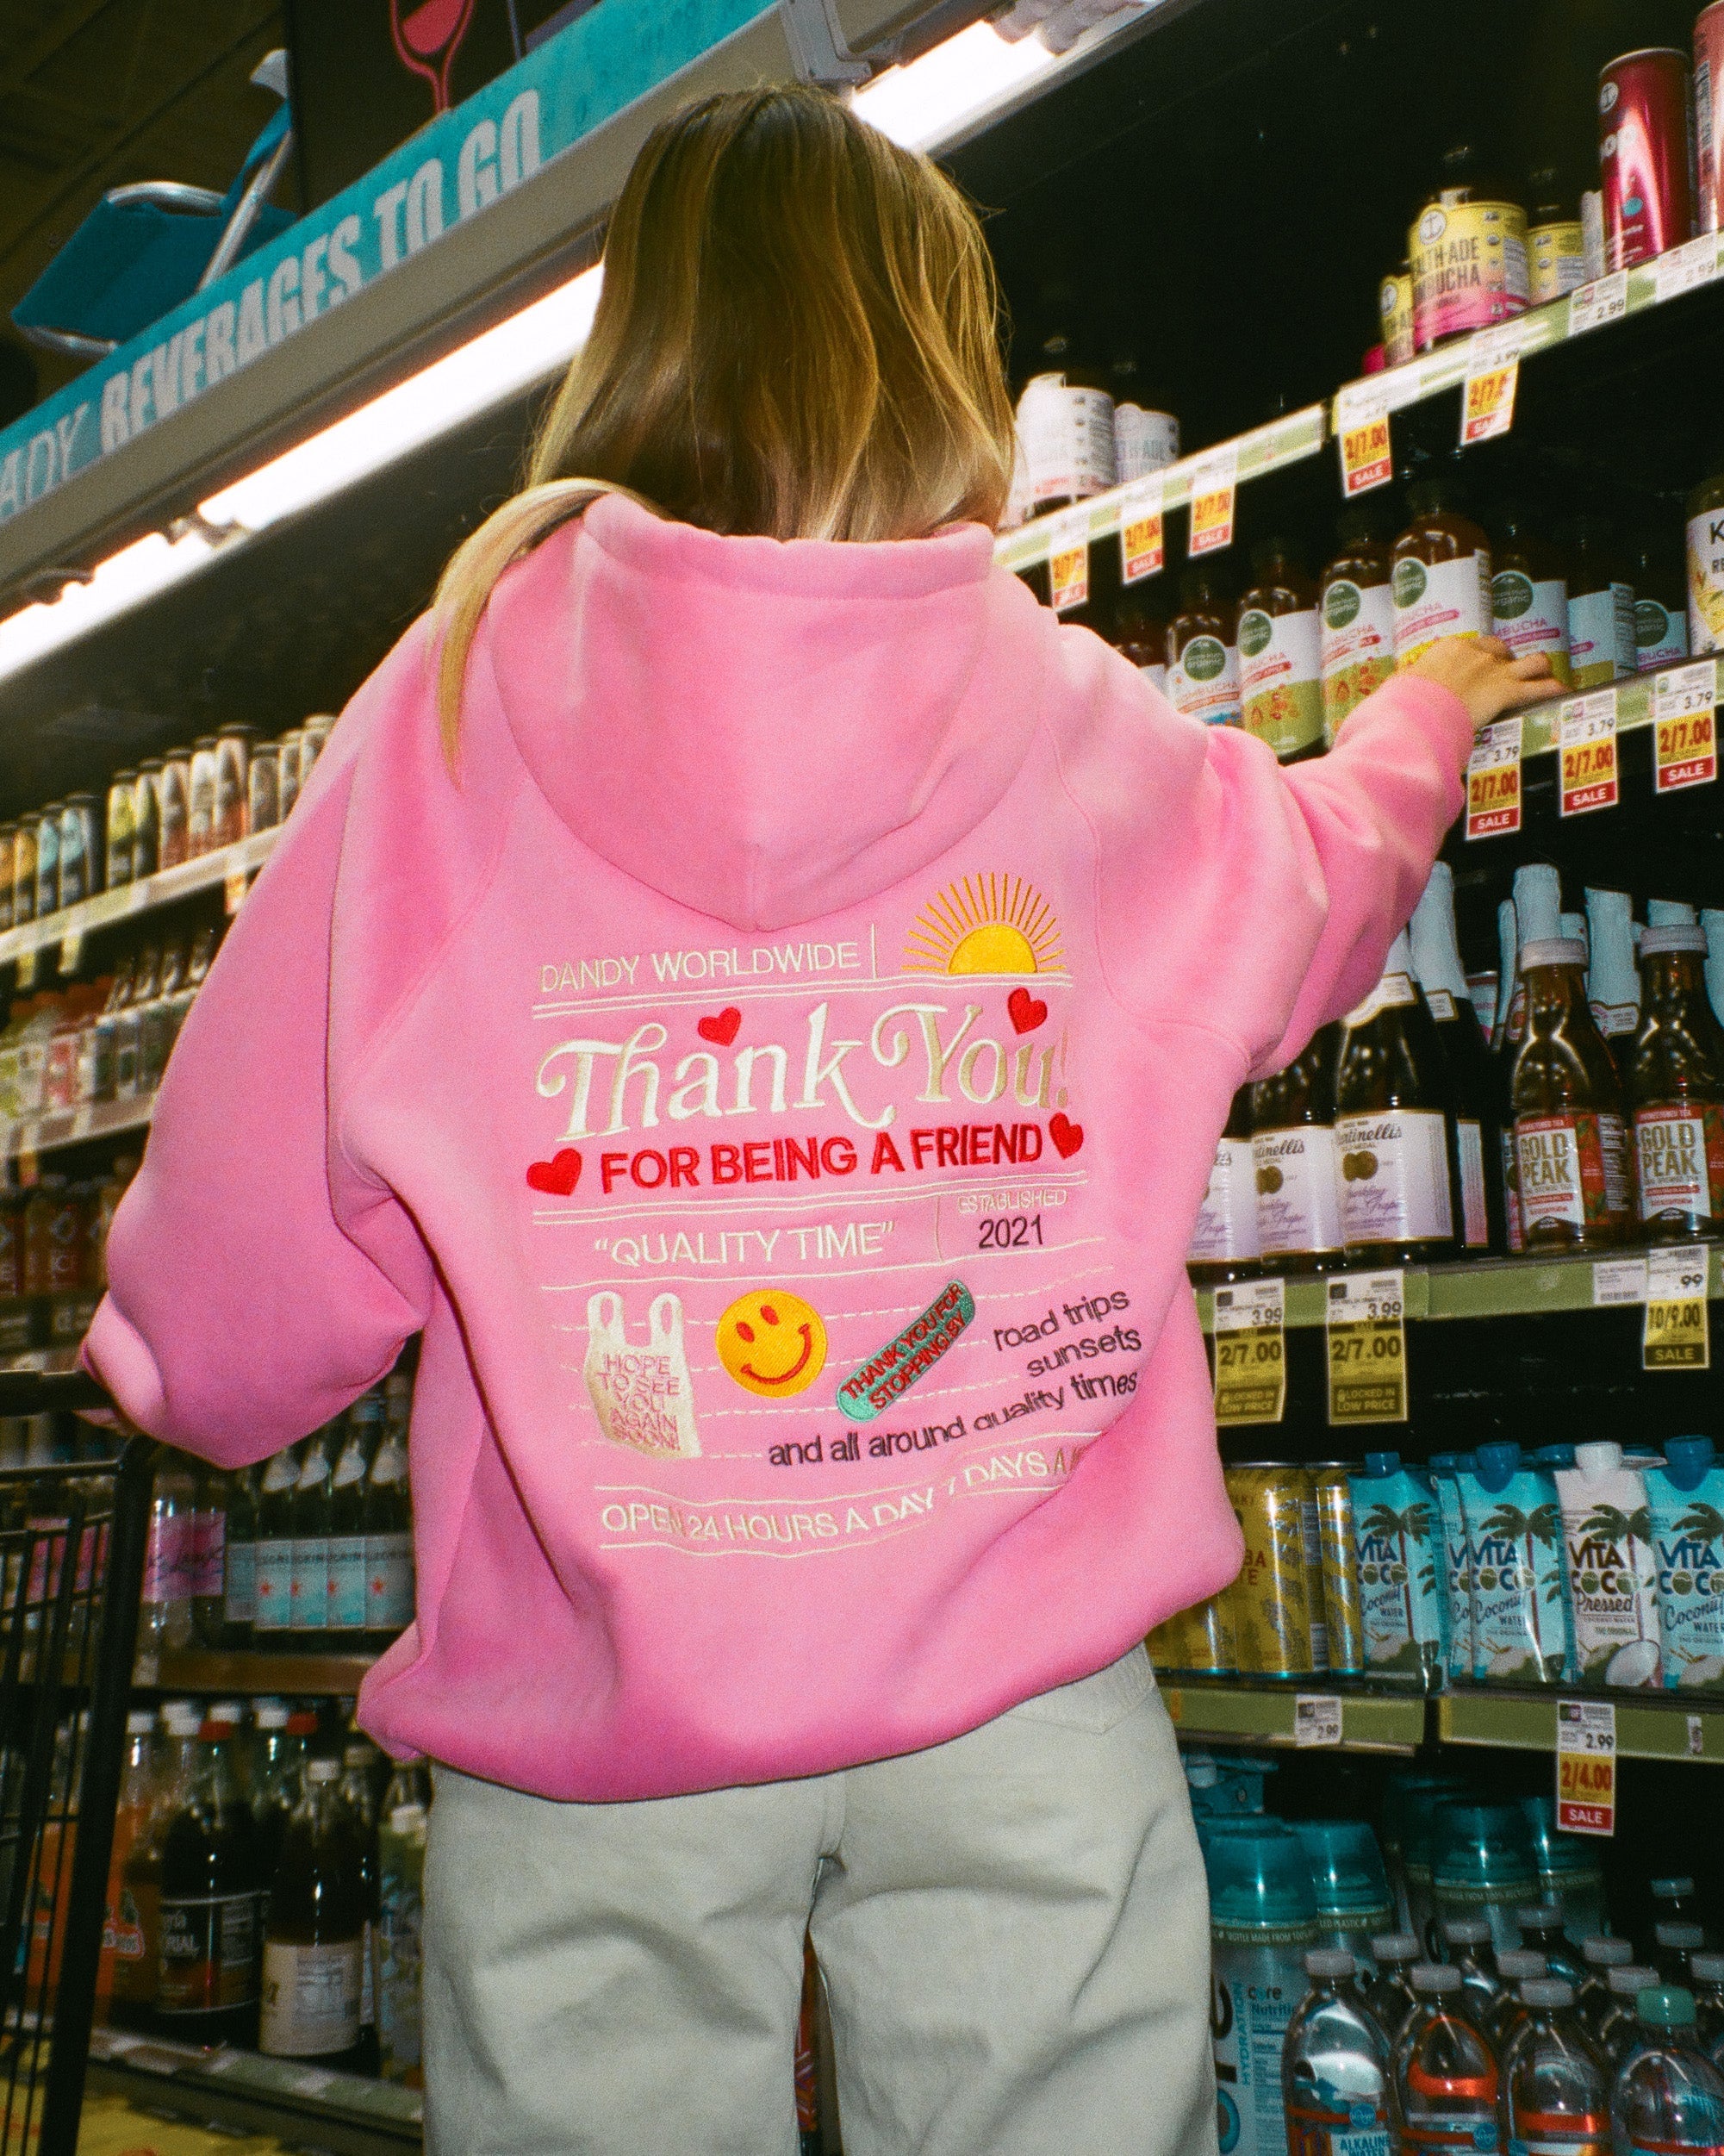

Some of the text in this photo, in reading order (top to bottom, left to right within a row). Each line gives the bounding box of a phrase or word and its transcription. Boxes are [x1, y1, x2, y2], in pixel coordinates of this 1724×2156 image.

[100, 215, 363, 454] BEVERAGES
[374, 158, 444, 270] TO
[458, 90, 541, 221] GO
[1596, 299, 1625, 321] 2.99
[1684, 690, 1713, 710] 3.79
[1588, 717, 1615, 736] 3.79
[1659, 718, 1712, 752] 2/7.00
[1493, 745, 1519, 763] 3.79
[1565, 745, 1614, 779] 2/7.00
[1667, 763, 1705, 782] SALE
[1471, 770, 1518, 804] 2/7.00
[1572, 788, 1607, 807] SALE
[1477, 813, 1510, 830] SALE
[538, 942, 862, 993] DANDY WORLDWIDE
[535, 1001, 1070, 1142] Thank You!
[1519, 1132, 1568, 1162] GOLD
[1640, 1122, 1696, 1153] GOLD
[601, 1123, 1043, 1194] FOR BEING A FRIEND
[1640, 1148, 1699, 1179] PEAK
[1522, 1158, 1572, 1187] PEAK
[957, 1188, 1068, 1214] ESTABLISHED
[978, 1213, 1043, 1249] 2021
[993, 1291, 1130, 1352] road trips
[1252, 1306, 1283, 1325] 3.99
[1367, 1300, 1402, 1320] 3.99
[840, 1282, 963, 1400] THANK YOU FOR
[1026, 1324, 1142, 1378] sunsets
[1220, 1340, 1281, 1367] 2/7.00
[1332, 1336, 1401, 1362] 2/7.00
[603, 1352, 671, 1378] HOPE
[868, 1309, 967, 1411] STOPPING BY
[1654, 1348, 1695, 1362] SALE
[595, 1372, 681, 1396] TO SEE
[1229, 1390, 1275, 1401] LOCKED IN
[1346, 1387, 1396, 1399] LOCKED IN
[614, 1392, 665, 1413] YOU
[1220, 1399, 1273, 1412] LOW PRICE
[1337, 1399, 1396, 1412] LOW PRICE
[609, 1407, 680, 1434] AGAIN
[768, 1370, 1138, 1467] and all around quality times
[602, 1503, 686, 1536] OPEN
[688, 1515, 723, 1541] 24
[725, 1511, 840, 1542] HOURS
[845, 1506, 870, 1534] A
[871, 1487, 935, 1527] DAY
[963, 1450, 1049, 1487] DAYS
[1354, 1534, 1398, 1563] VITA
[1470, 1535, 1518, 1566] VITA
[1568, 1536, 1627, 1569] VITA
[1658, 1536, 1722, 1570] VITA
[1356, 1562, 1409, 1586] COCO
[1471, 1567, 1535, 1592] COCO
[1570, 1569, 1640, 1595] COCO
[1659, 1570, 1724, 1595] COCO
[1379, 1606, 1403, 1617] WATER
[1576, 1593, 1634, 1615] Pressed
[1585, 1731, 1614, 1750] 2.99
[1561, 1760, 1613, 1792] 2/4.00
[1568, 1808, 1603, 1825] SALE
[1249, 1985, 1282, 2000] core
